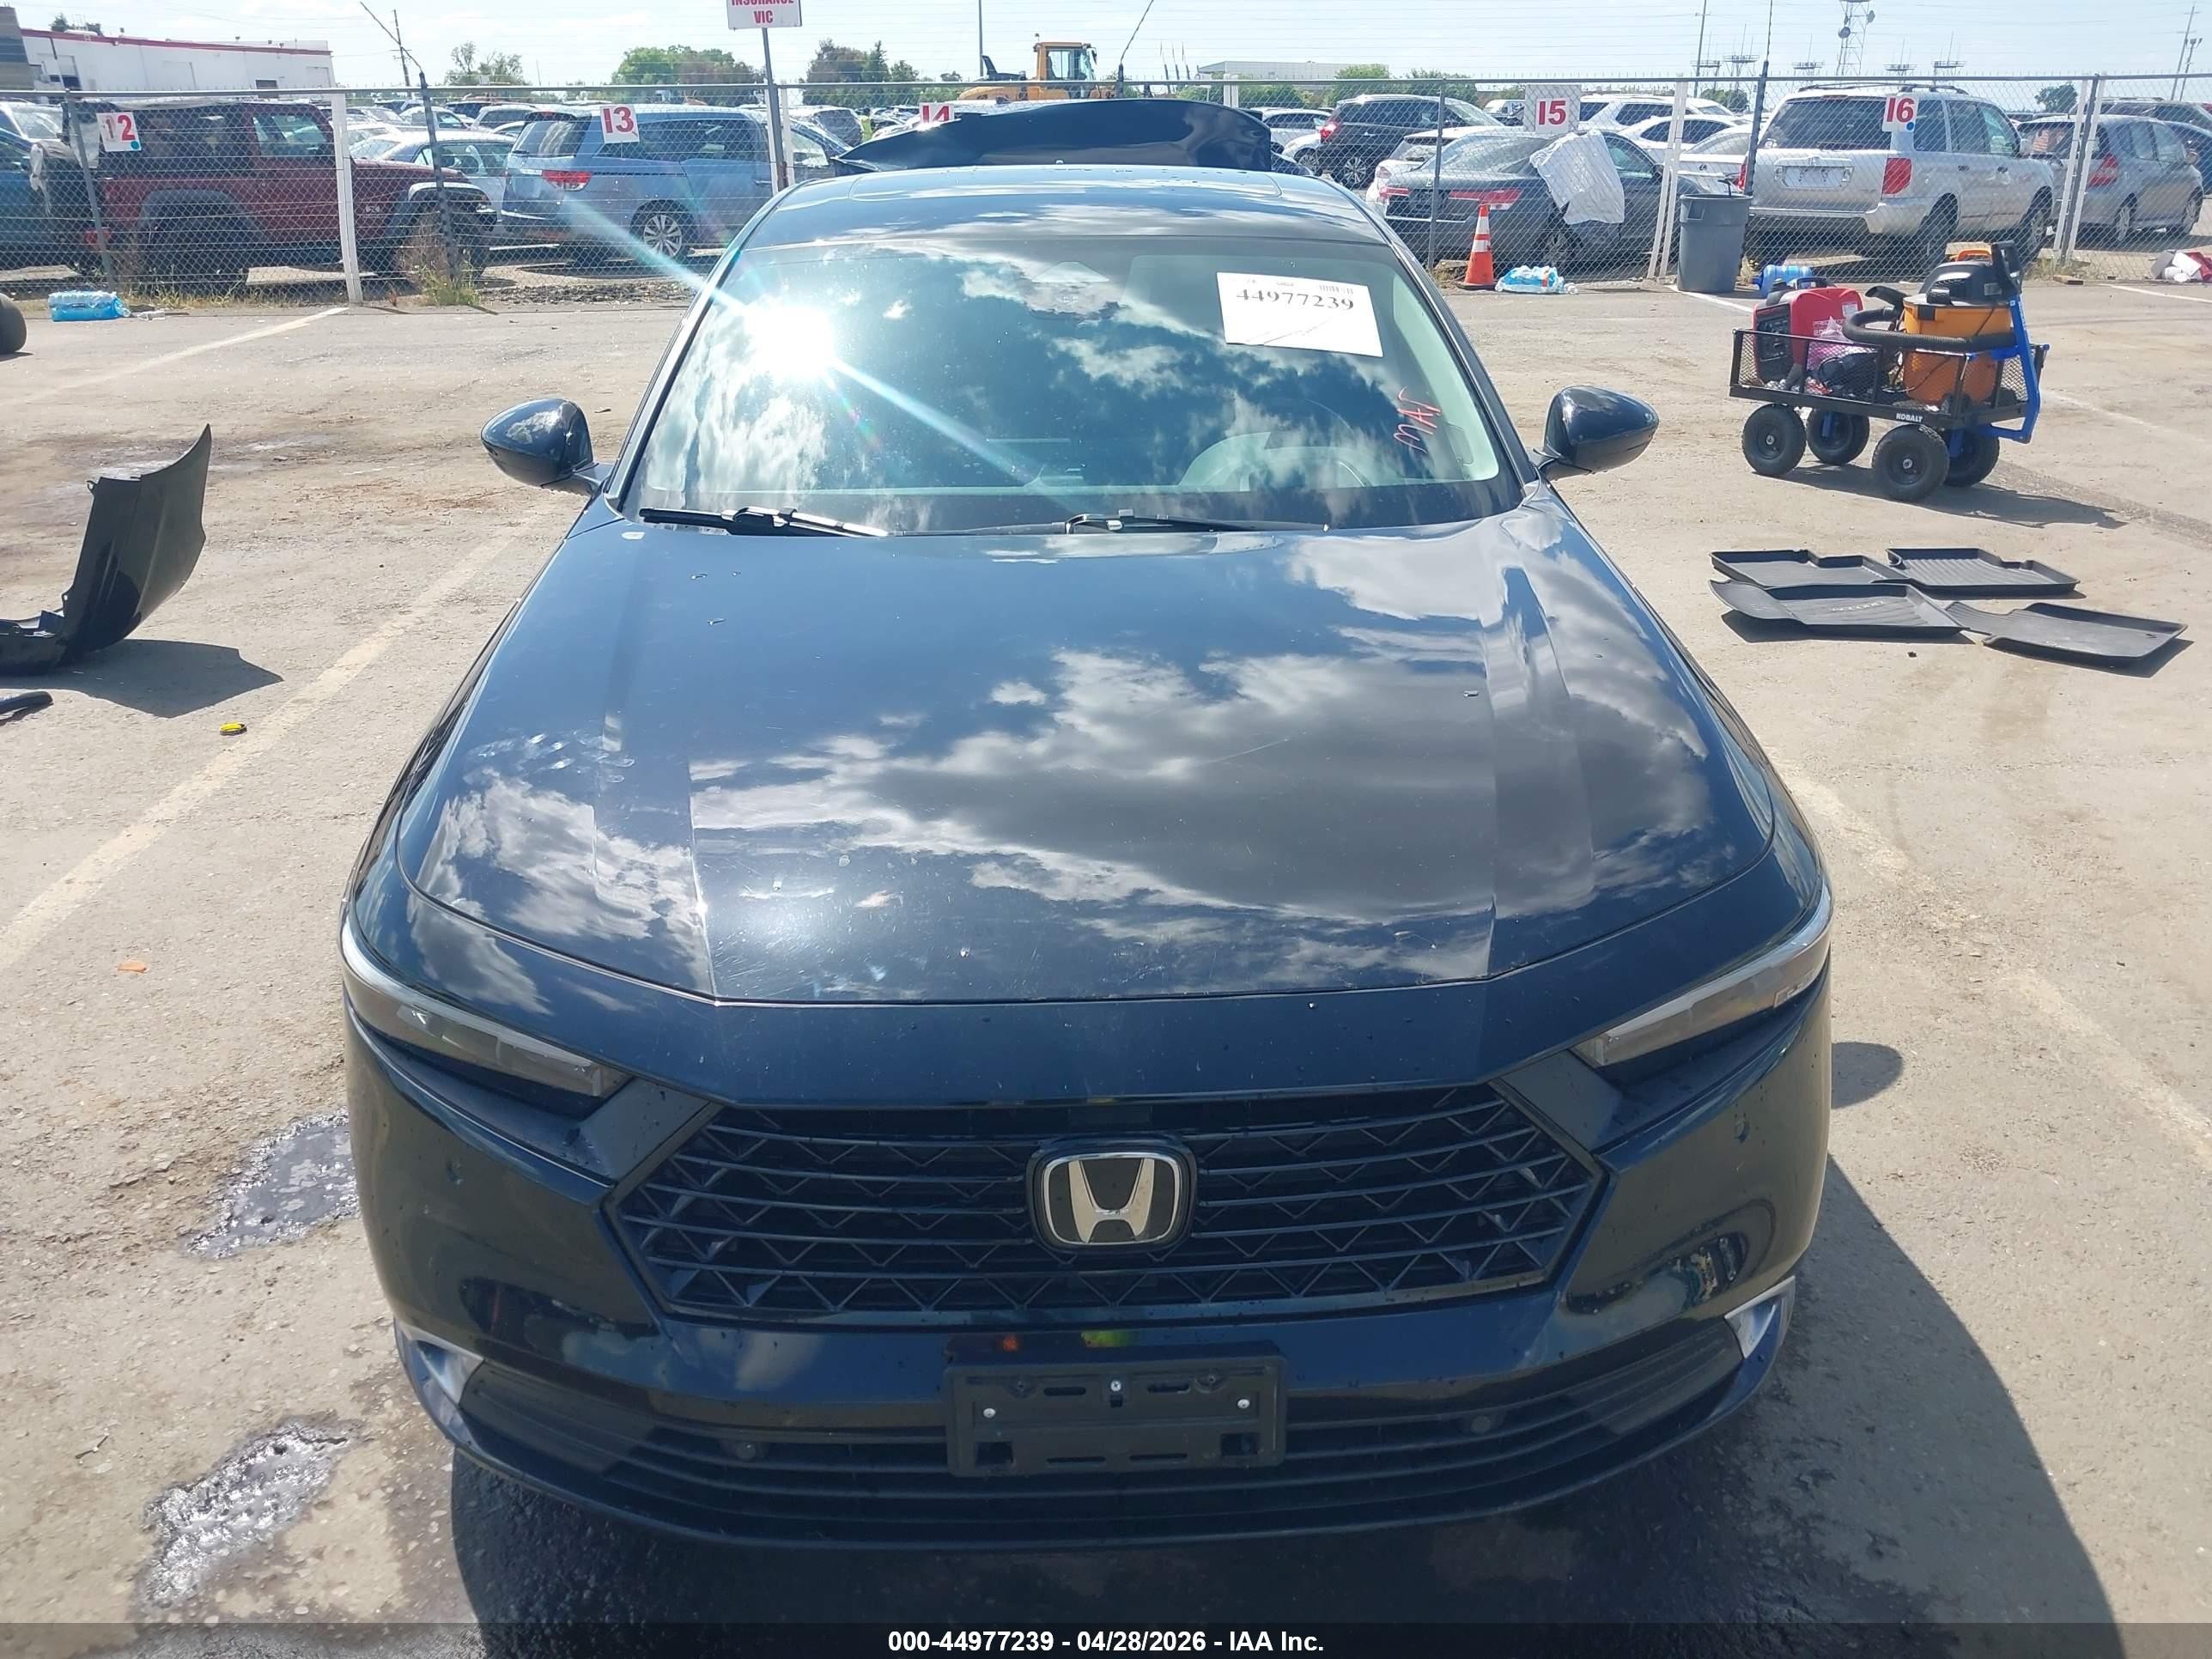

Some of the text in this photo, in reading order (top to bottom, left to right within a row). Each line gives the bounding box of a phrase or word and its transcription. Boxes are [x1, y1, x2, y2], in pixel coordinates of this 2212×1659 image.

[754, 10, 774, 23] VIC
[603, 106, 634, 133] 13
[922, 106, 949, 124] 14
[1539, 100, 1566, 125] 15
[1887, 97, 1915, 123] 16
[104, 114, 136, 141] 12
[1236, 289, 1354, 310] 44977239
[1896, 412, 1923, 422] KOBALT
